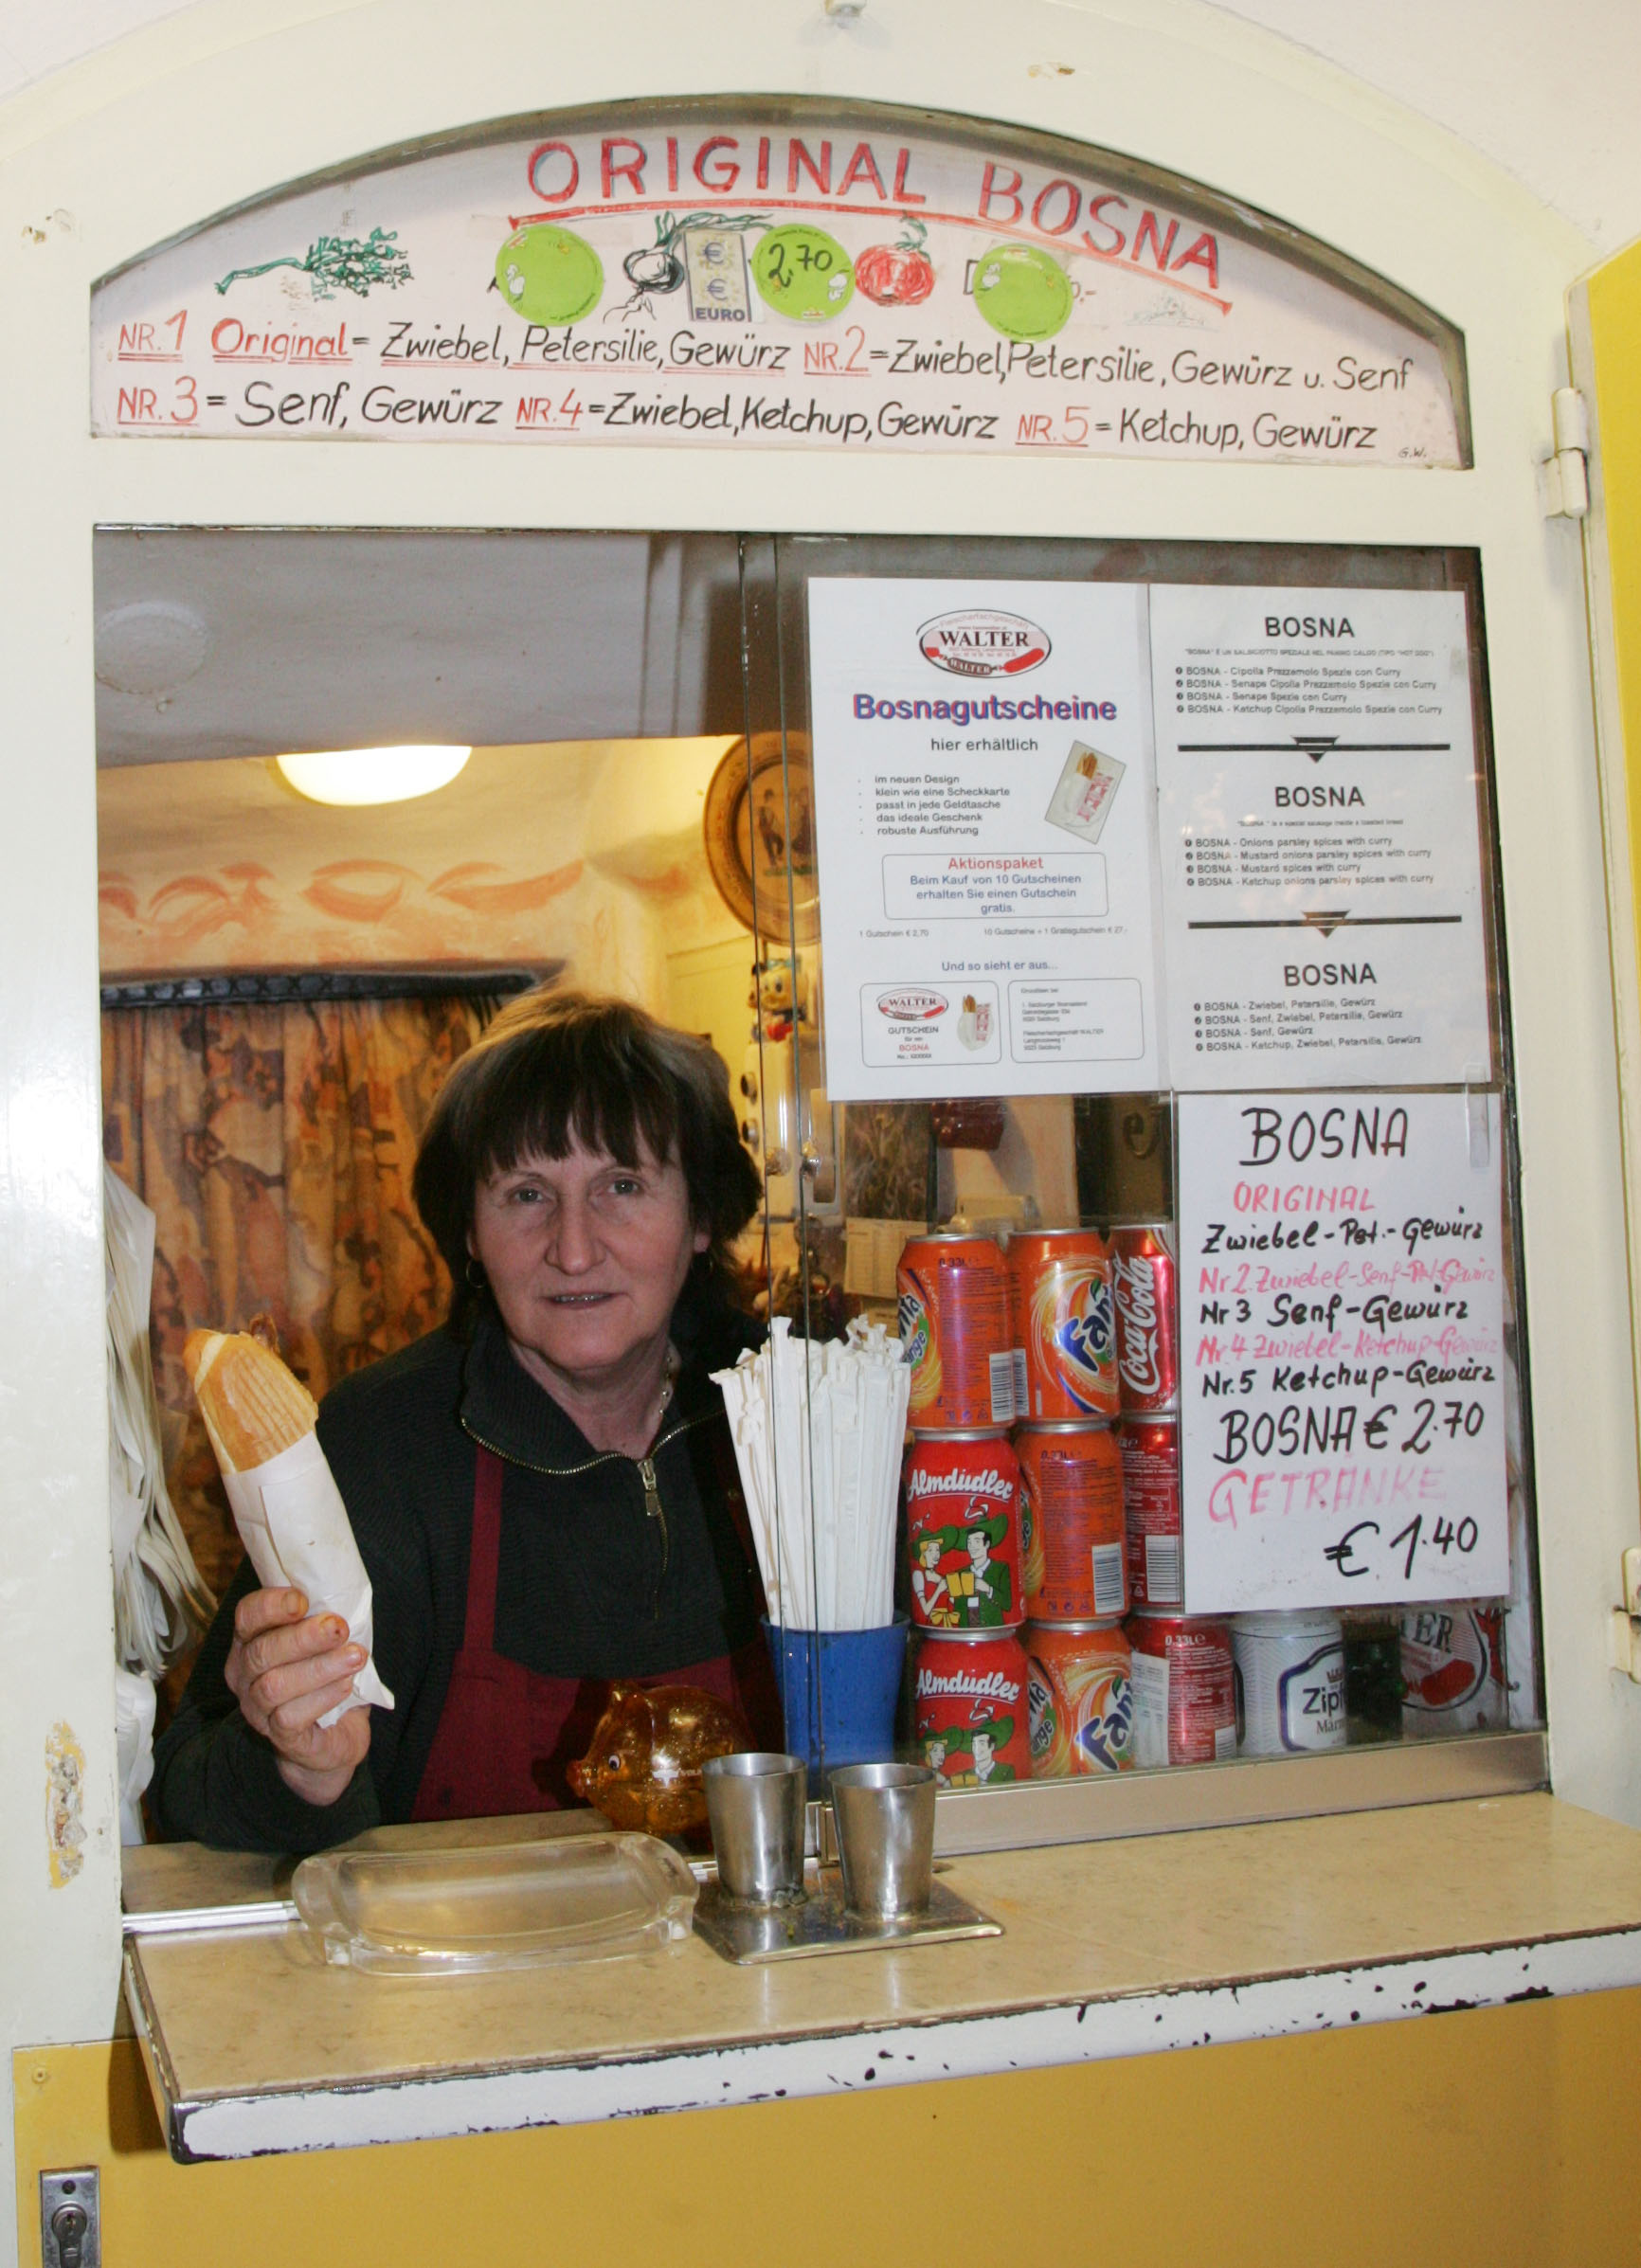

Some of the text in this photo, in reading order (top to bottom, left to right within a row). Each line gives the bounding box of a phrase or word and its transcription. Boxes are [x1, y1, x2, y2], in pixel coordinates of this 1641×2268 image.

[527, 135, 1218, 290] ORIGINAL BOSNA
[694, 307, 746, 322] EURO
[210, 316, 348, 360] Original
[670, 330, 790, 367] Gewürz
[1172, 350, 1291, 387] Gewürz
[1333, 356, 1414, 391] Senf
[361, 386, 503, 424] Gewürz
[877, 401, 1000, 440] Gewürz
[1253, 413, 1377, 449] Gewürz
[1265, 617, 1355, 638] BOSNA
[939, 631, 1030, 647] WALTER
[1186, 667, 1221, 675] BOSNA
[1230, 666, 1264, 677] Cipolla
[1267, 666, 1320, 676] Prezzemolo
[1322, 666, 1352, 677] Spezie
[1375, 667, 1401, 678] Curry
[1186, 679, 1437, 691] BOSNA Senape Cipolla Prezzemolo Spezie con Curry
[1186, 692, 1222, 701] BOSNA
[1233, 693, 1268, 703] Senape
[1271, 693, 1299, 703] Spezie
[1322, 693, 1347, 704] Curry
[853, 693, 1118, 726] Bosnagutscheine
[930, 737, 1038, 751] hier erhältlich
[925, 774, 960, 786] Design
[875, 787, 900, 797] klein
[922, 787, 945, 797] eine
[947, 787, 1010, 797] Scheckkarte
[1274, 786, 1365, 807] BOSNA
[918, 801, 941, 812] jede
[944, 800, 1001, 809] Geldtasche
[876, 813, 983, 822] das ideale Geschenk
[877, 825, 979, 837] robuste Ausführung
[1196, 837, 1393, 849] BOSNA Onions parsley spices with curry
[947, 856, 1044, 871] Aktionspaket
[1197, 863, 1361, 873] BOSNA Mustard spices with curry
[910, 873, 1082, 885] Beim Kauf von 10 Gutscheinen
[916, 888, 1076, 900] erhalten Sie einen Gutschein
[942, 962, 965, 971] Und
[983, 961, 1011, 971] sieht
[1014, 963, 1026, 971] er
[1284, 963, 1377, 987] BOSNA
[1204, 1001, 1239, 1012] BOSNA
[1341, 997, 1376, 1007] Gewürz
[1205, 1015, 1240, 1025] BOSNA
[1367, 1009, 1403, 1019] Gewürz
[888, 1026, 939, 1035] GUTSCHEIN
[1205, 1028, 1241, 1038] BOSNA
[1277, 1025, 1313, 1035] Gewürz
[1206, 1042, 1242, 1052] BOSNA
[1387, 1035, 1421, 1045] Gewürz
[1239, 1107, 1408, 1166] BOSNA
[1233, 1181, 1376, 1213] ORIGINAL
[1213, 1405, 1357, 1465] BOSNA
[1401, 1398, 1485, 1454] 2.70
[909, 1467, 1014, 1502] Almdudler
[1323, 1514, 1478, 1579] € 1.40
[915, 1668, 1020, 1702] Almdudler
